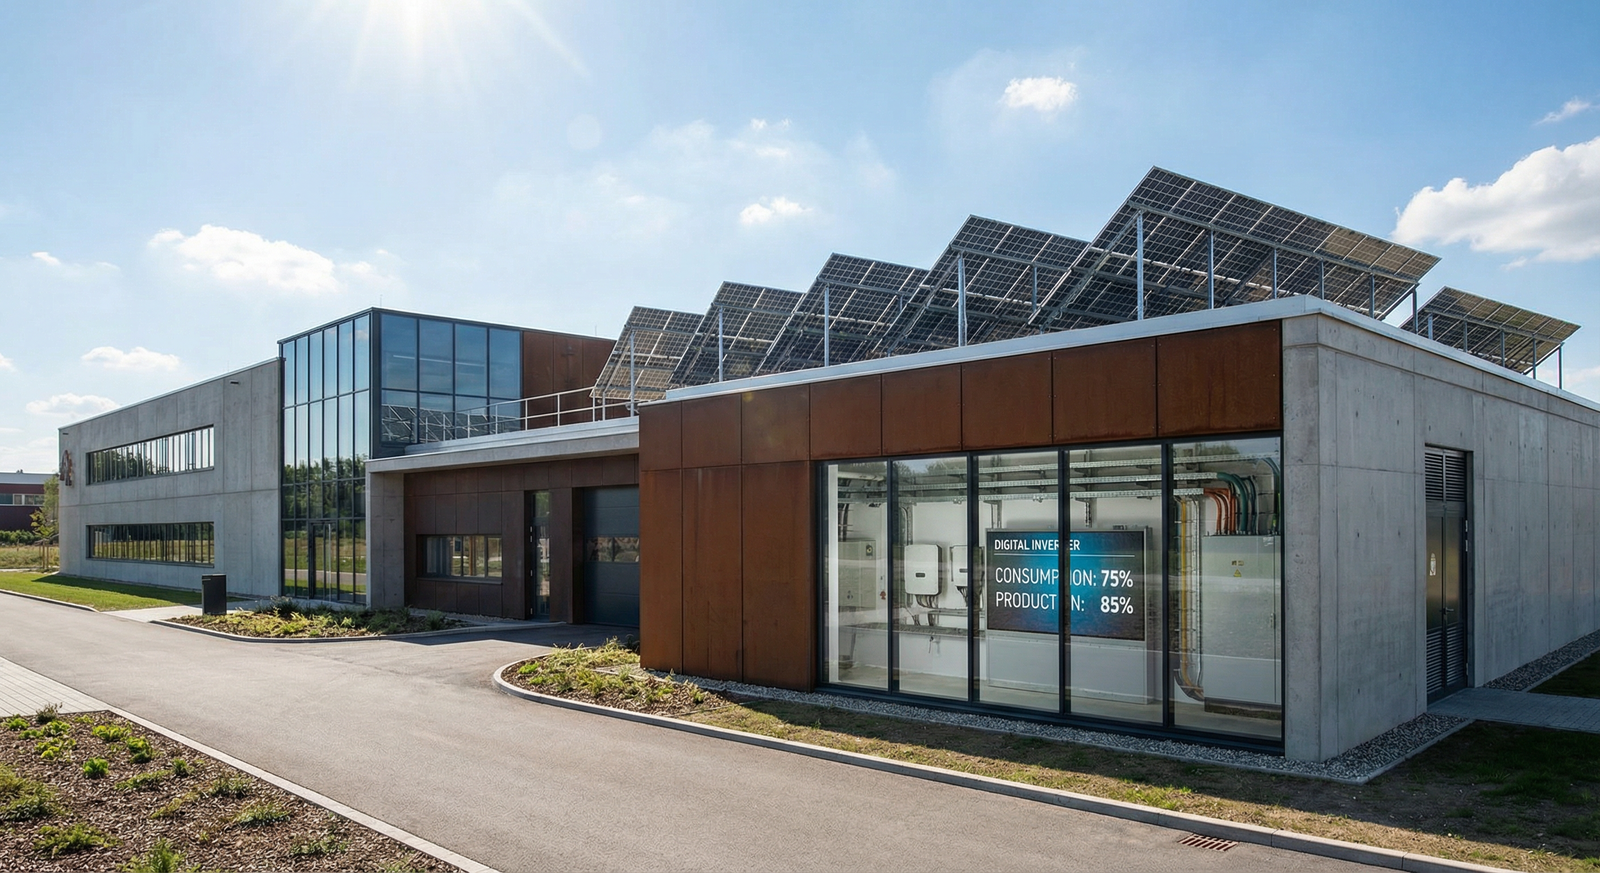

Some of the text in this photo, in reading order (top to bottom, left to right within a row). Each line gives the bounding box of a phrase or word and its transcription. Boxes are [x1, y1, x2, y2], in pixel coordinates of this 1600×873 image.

[994, 539, 1080, 551] DIGITAL INVERER
[995, 567, 1134, 588] CONSUMPION: 75%
[995, 591, 1134, 614] PRODUCTN: 85%
